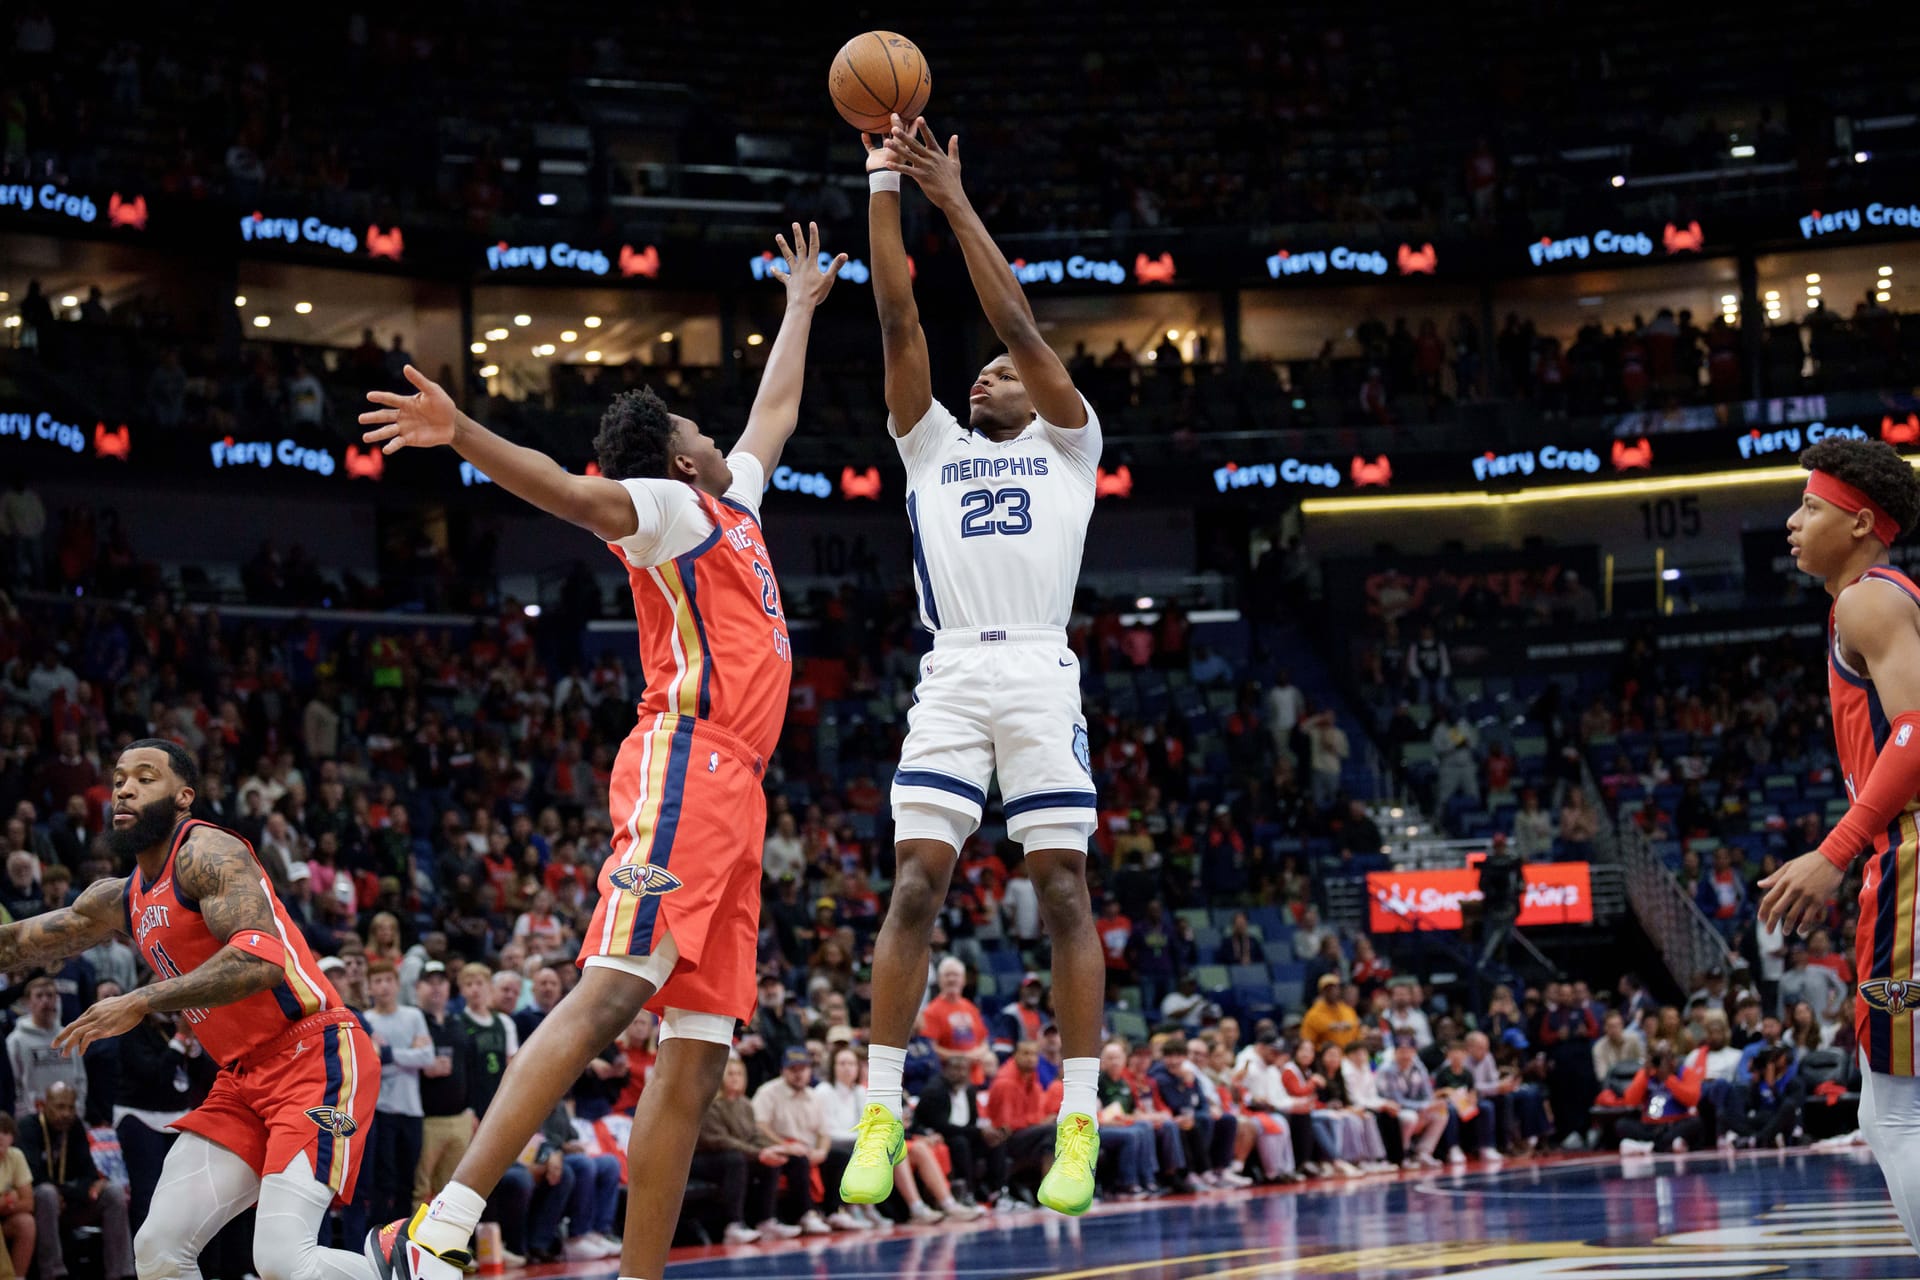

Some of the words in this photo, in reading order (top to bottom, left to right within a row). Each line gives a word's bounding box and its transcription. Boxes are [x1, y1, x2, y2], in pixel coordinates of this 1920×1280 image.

[38, 184, 97, 222] Crab
[239, 213, 300, 243] Fiery
[301, 216, 358, 254] Crab
[1799, 208, 1861, 239] Fiery
[486, 243, 547, 271] Fiery
[549, 242, 610, 276] Crab
[1266, 250, 1328, 279] Fiery
[1329, 246, 1389, 275] Crab
[1528, 235, 1591, 266] Fiery
[1593, 229, 1653, 256] Crab
[1066, 255, 1126, 285] Crab
[35, 412, 85, 453] Crab
[1737, 429, 1796, 460] Fiery
[210, 438, 273, 469] Fiery
[276, 438, 335, 476] Crab
[940, 456, 1049, 485] MEMPHIS
[1471, 452, 1536, 481] Fiery
[1538, 445, 1601, 473] Crab
[771, 465, 833, 499] Crab
[1213, 463, 1277, 493] Fiery
[1279, 458, 1341, 488] Crab
[960, 487, 1032, 539] 23
[1639, 496, 1702, 541] 105
[486, 1052, 500, 1074] 3
